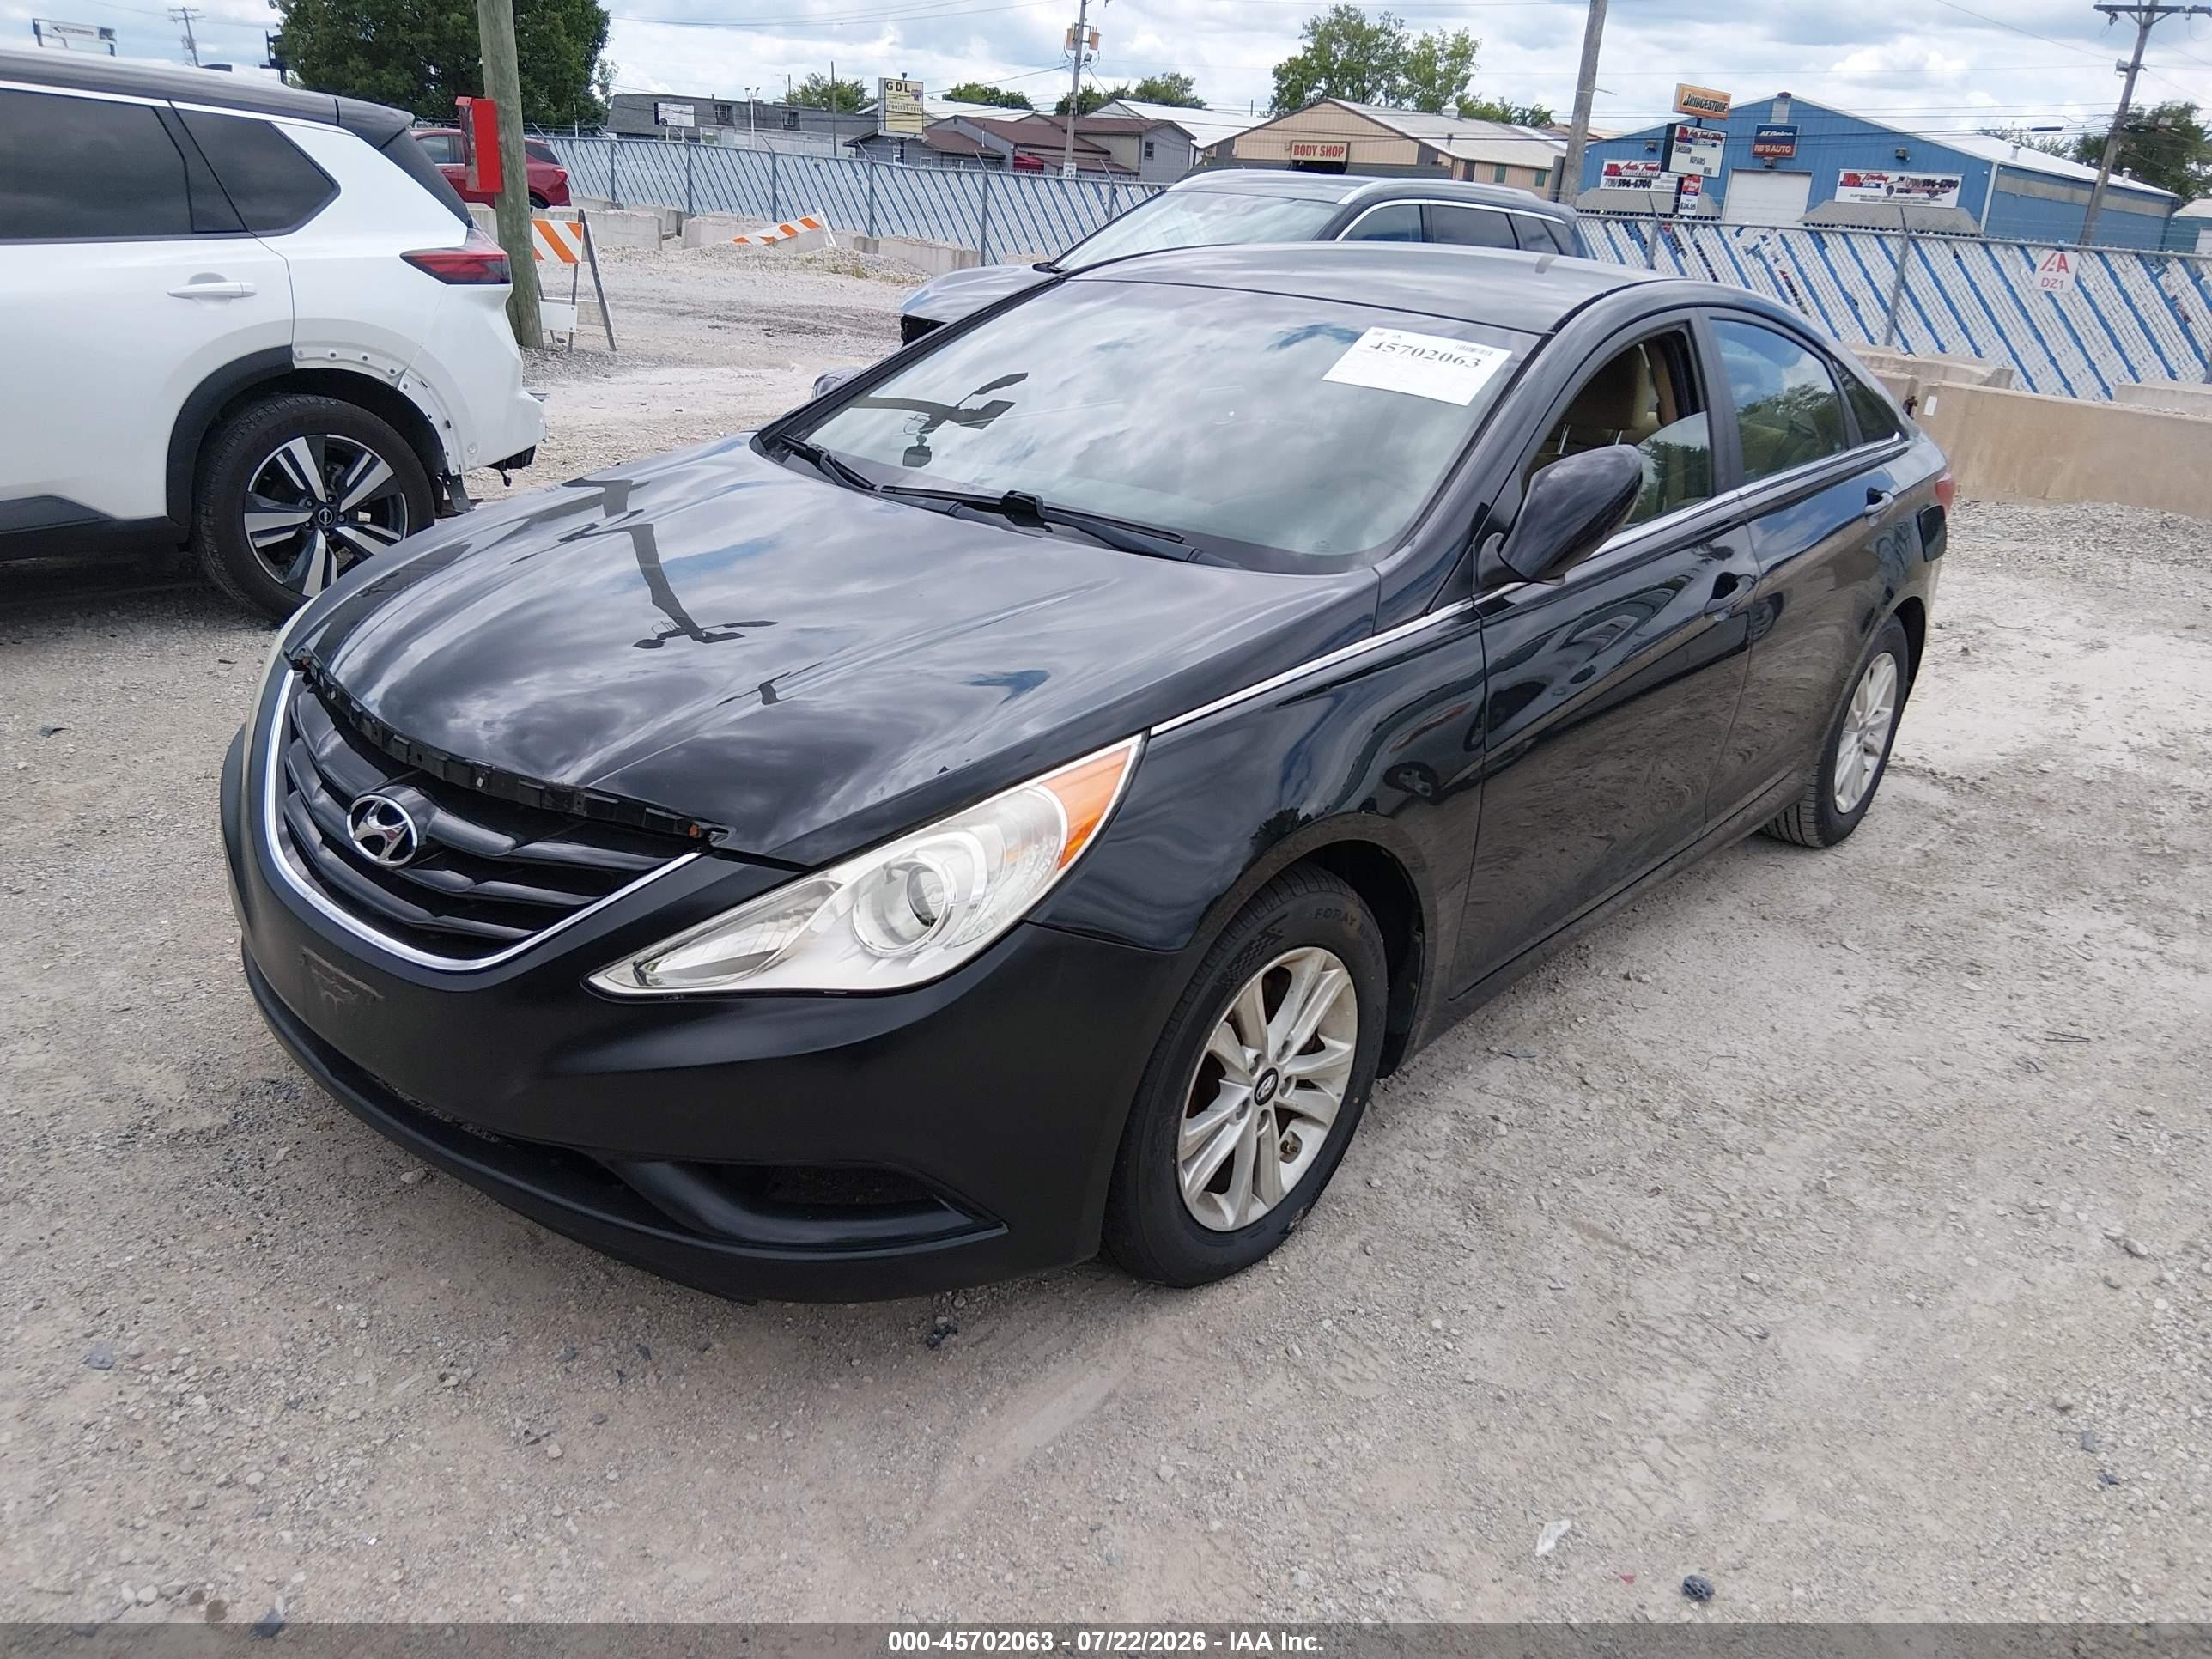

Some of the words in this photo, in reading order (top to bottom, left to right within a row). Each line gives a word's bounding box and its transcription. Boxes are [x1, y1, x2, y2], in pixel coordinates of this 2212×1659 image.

[1683, 94, 1728, 113] BRIDGESTONE
[1293, 145, 1318, 156] BODY
[1320, 145, 1345, 157] SHOP
[2040, 276, 2064, 289] DZ1
[1370, 341, 1482, 368] 45702063
